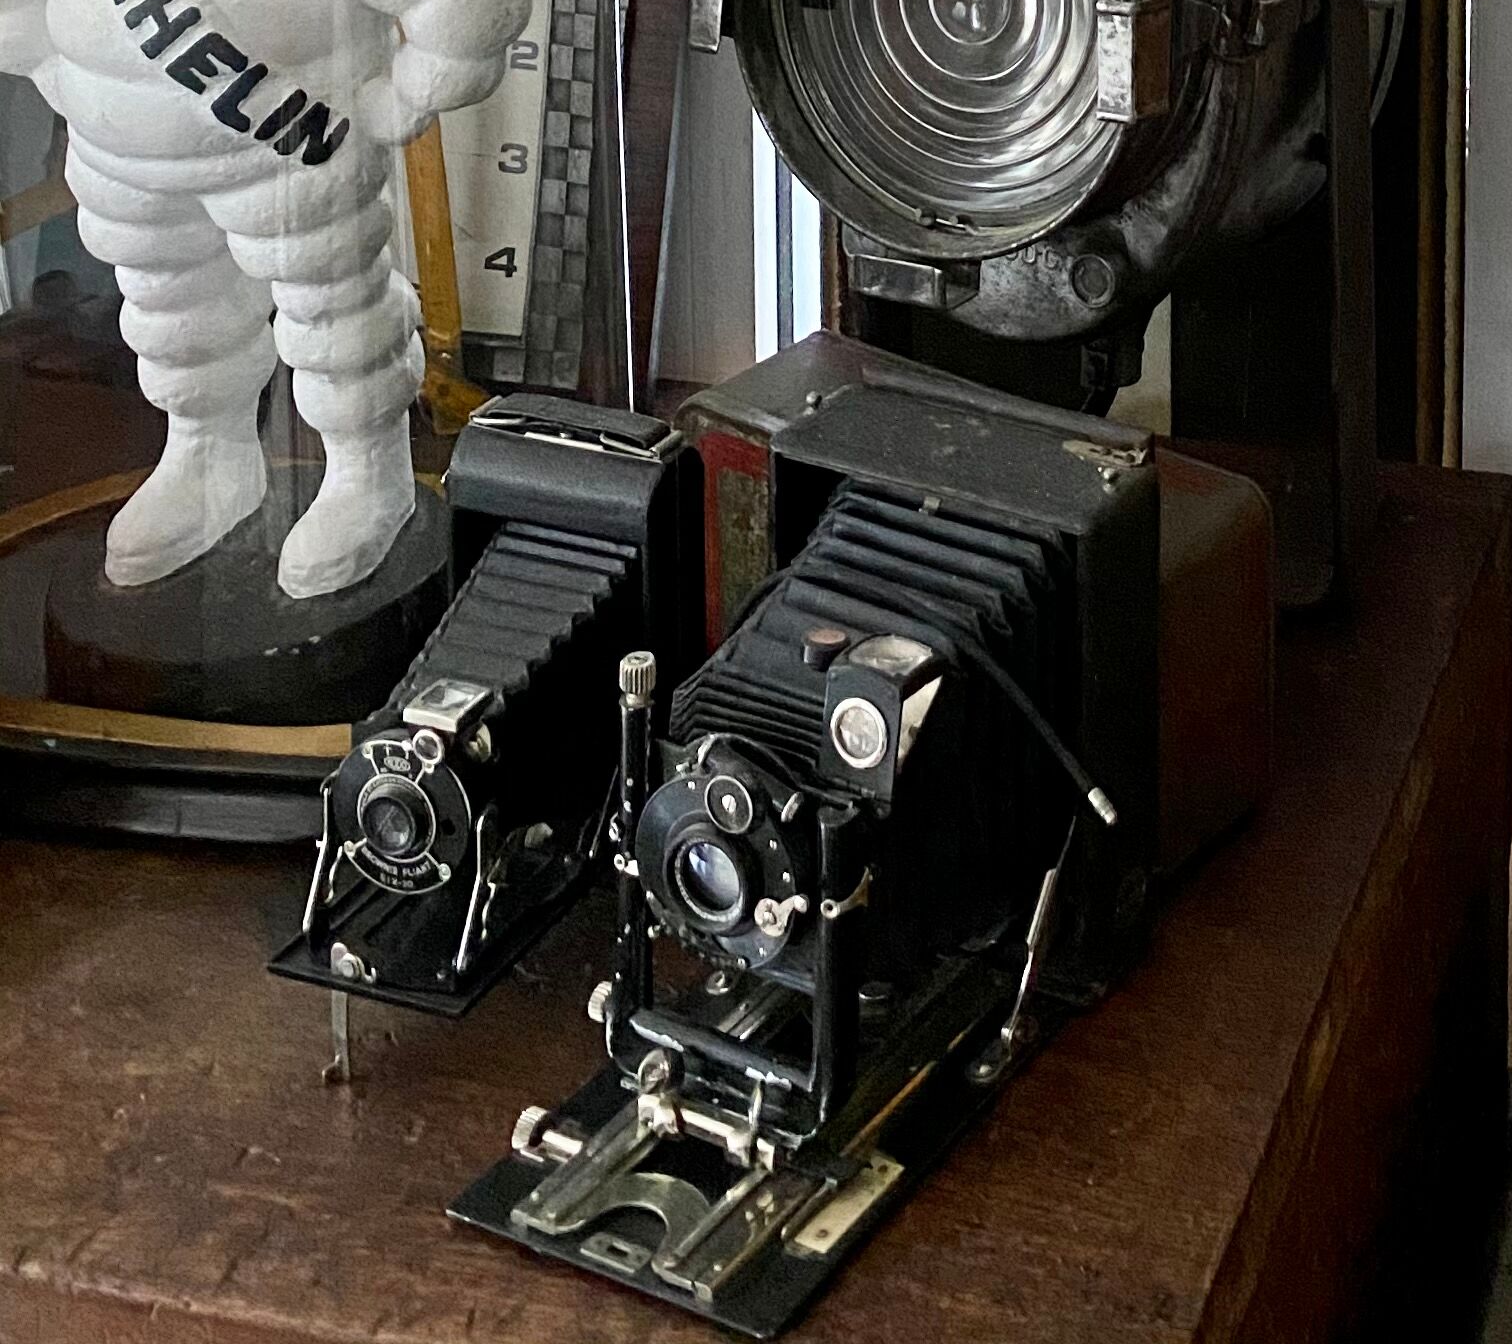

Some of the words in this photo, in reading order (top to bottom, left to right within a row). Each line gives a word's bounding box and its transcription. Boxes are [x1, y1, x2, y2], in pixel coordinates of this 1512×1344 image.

[510, 40, 539, 71] 2
[498, 143, 528, 174] 3
[484, 247, 517, 278] 4
